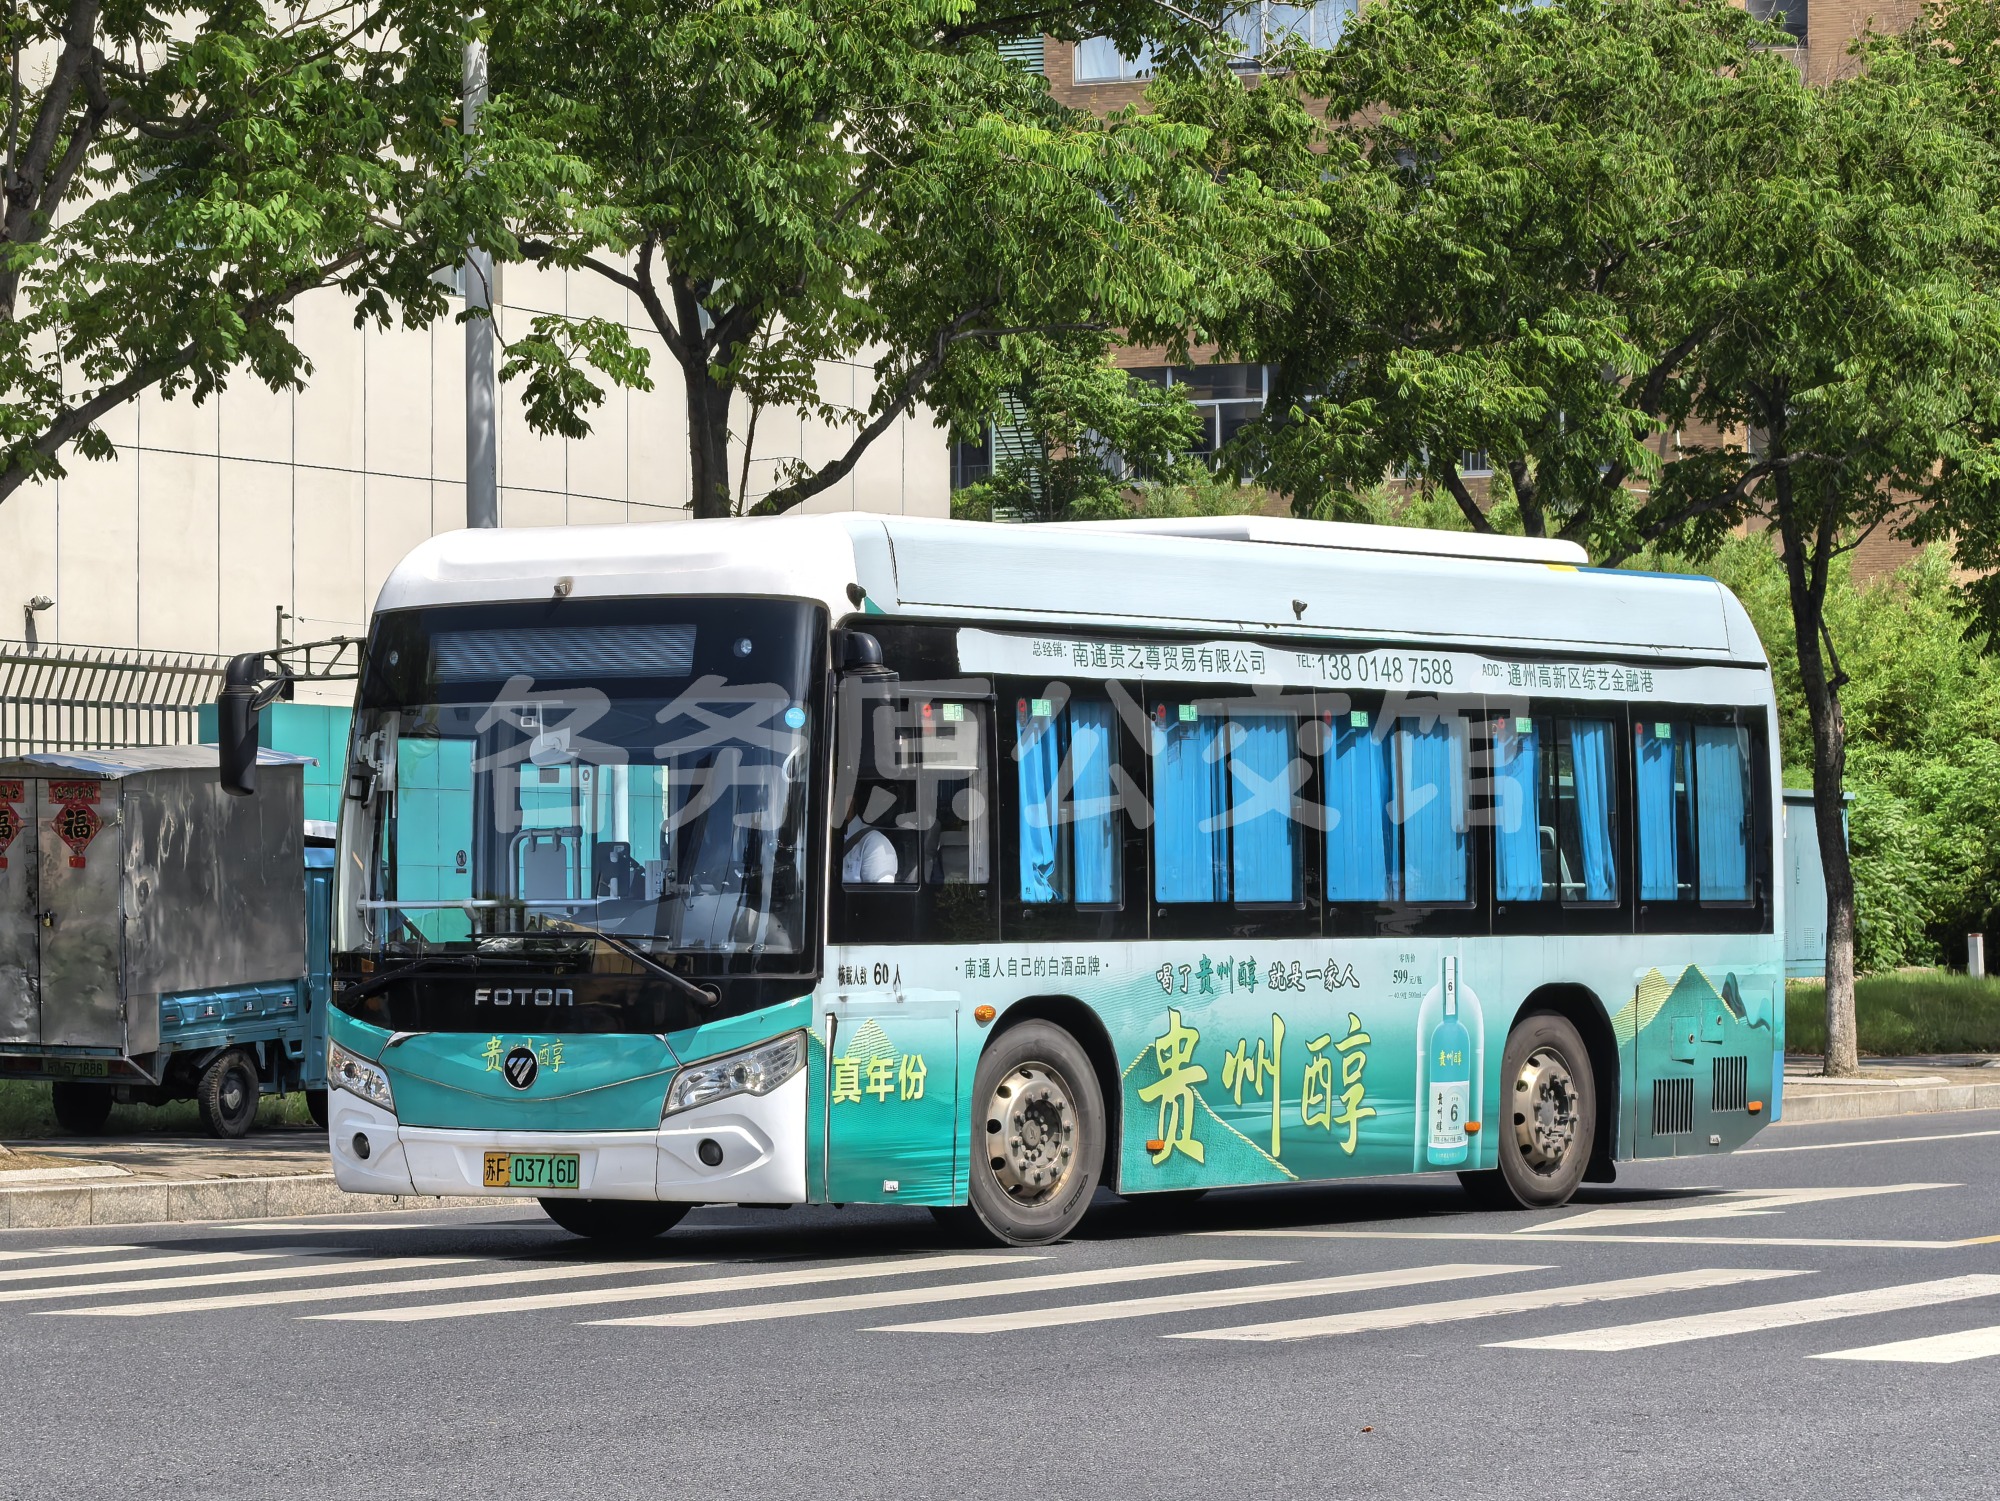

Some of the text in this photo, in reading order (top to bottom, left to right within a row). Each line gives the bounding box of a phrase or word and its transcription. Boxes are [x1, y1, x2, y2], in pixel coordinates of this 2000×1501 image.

[1071, 641, 1266, 675] 南通贵之尊贸易有限公司
[1317, 654, 1351, 681] 138
[1357, 655, 1403, 683] 0148
[1408, 658, 1453, 685] 7588
[1507, 663, 1654, 693] 通州高新区综艺金融港
[63, 808, 91, 840] 福
[873, 962, 889, 985] 60
[893, 963, 902, 985] 人
[1392, 969, 1408, 984] 599
[1447, 981, 1453, 991] 6
[474, 988, 574, 1006] FOTON
[832, 1053, 928, 1104] 真年份
[1137, 1005, 1378, 1166] 贵州醇
[1451, 1104, 1458, 1122] 6
